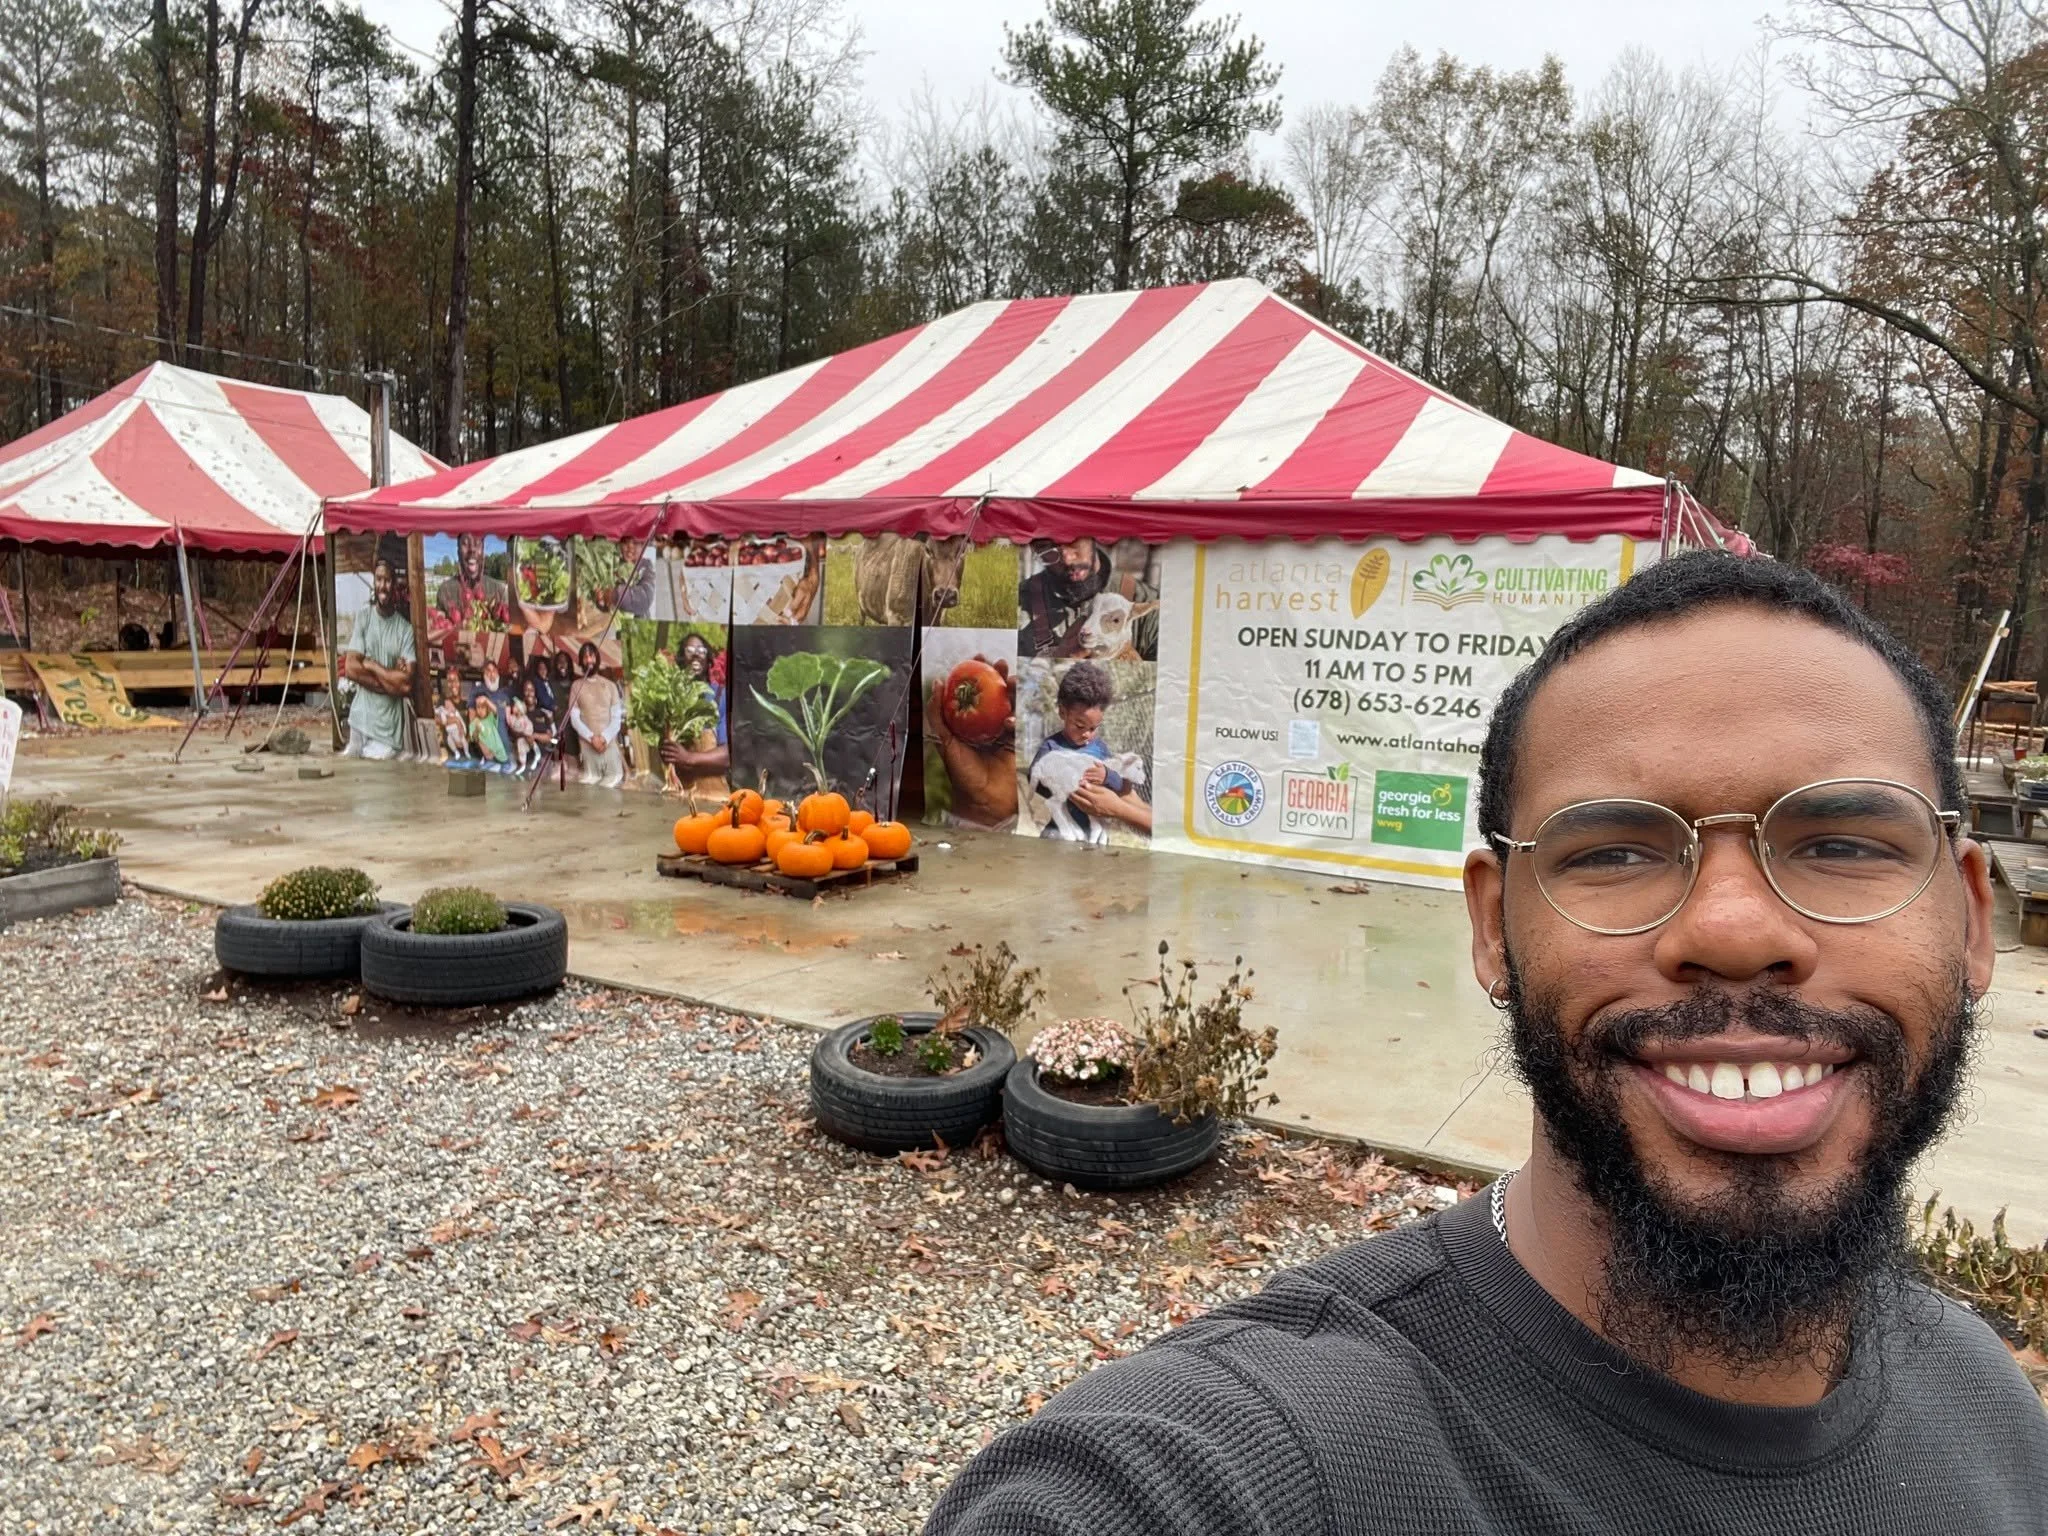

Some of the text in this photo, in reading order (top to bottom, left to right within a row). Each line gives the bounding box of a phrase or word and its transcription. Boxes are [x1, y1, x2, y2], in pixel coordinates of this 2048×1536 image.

[1228, 559, 1342, 583] atlanta
[1494, 567, 1608, 592] CULTIVATING
[1215, 583, 1339, 612] harvest
[1493, 592, 1604, 606] HUMANIT
[1237, 626, 1297, 648] OPEN
[1303, 628, 1408, 652] SUNDAY
[1415, 632, 1450, 654] TO
[1304, 658, 1472, 687] 11 AM TO 5 PM
[1293, 687, 1481, 719] (678) 653-6246
[1215, 727, 1260, 740] FOLLOW
[1215, 763, 1258, 783] CERTIFIED
[1208, 784, 1262, 824] NATURALLY GROWN
[1287, 778, 1348, 813] GEORGIA
[1379, 790, 1432, 805] georgia
[1286, 811, 1348, 830] grown
[1378, 803, 1461, 821] fresh for less
